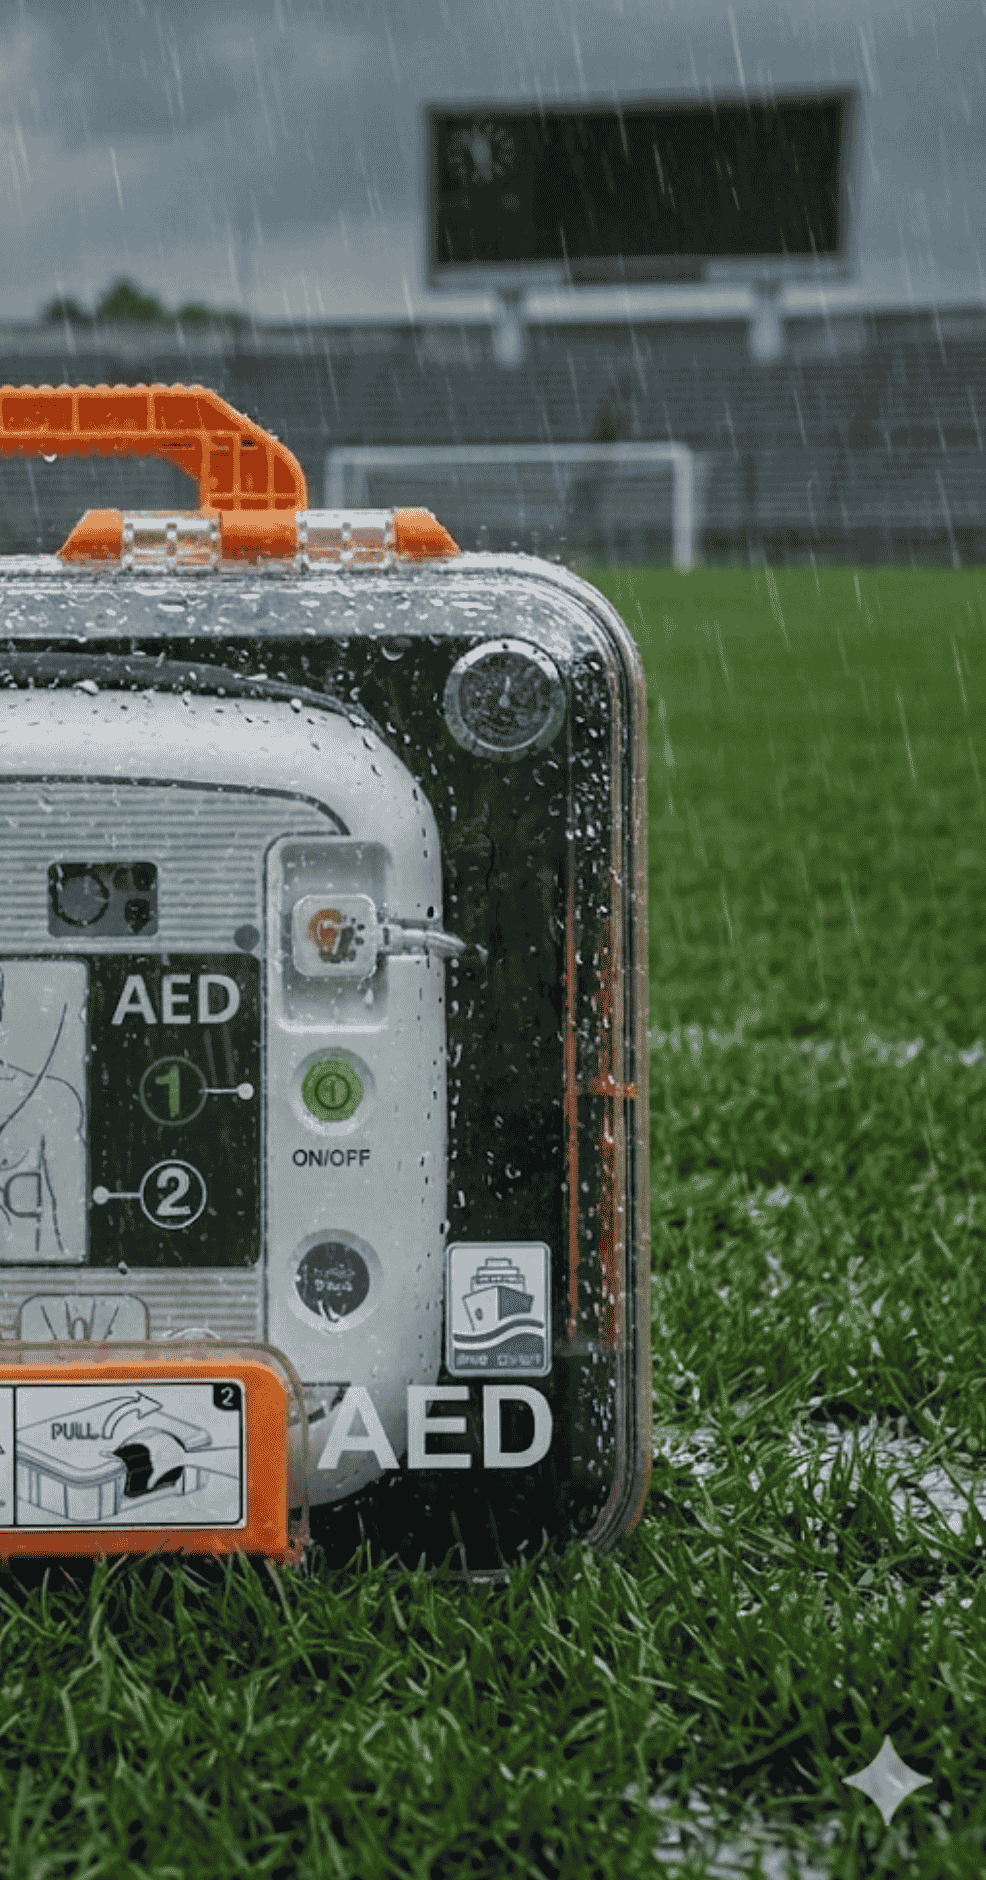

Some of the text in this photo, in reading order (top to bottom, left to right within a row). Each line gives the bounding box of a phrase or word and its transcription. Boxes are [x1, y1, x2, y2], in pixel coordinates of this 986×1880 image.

[111, 974, 240, 1026] AED
[155, 1064, 181, 1118] 1
[292, 1149, 371, 1167] ON/OFF
[156, 1167, 192, 1217] 2
[220, 1386, 234, 1407] 2
[50, 1422, 101, 1440] PULL
[317, 1385, 553, 1470] AED
